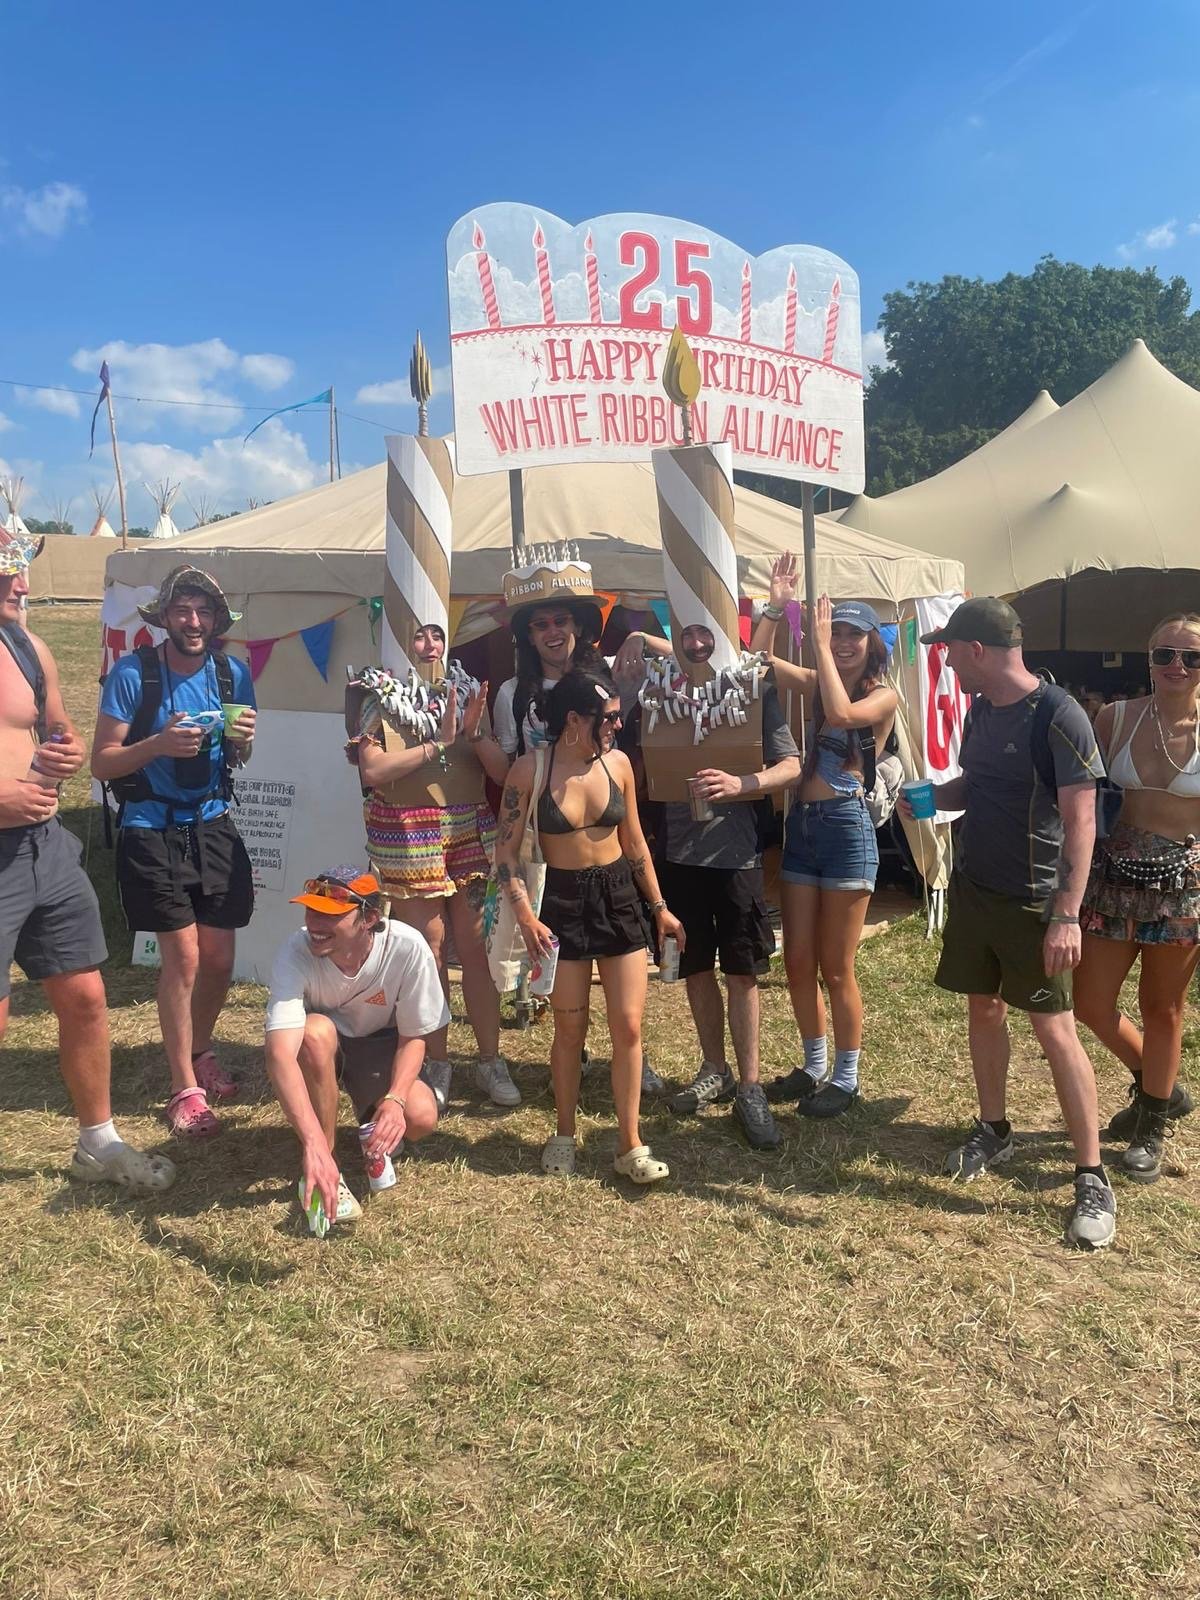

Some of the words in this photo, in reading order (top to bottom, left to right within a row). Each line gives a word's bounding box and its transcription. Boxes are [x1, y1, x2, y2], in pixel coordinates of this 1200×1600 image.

[618, 230, 714, 336] 25
[543, 338, 663, 383] HAPPY
[692, 348, 811, 406] RTHDAY
[479, 393, 592, 457] WHITE
[720, 404, 844, 473] ALLIANCE
[511, 581, 544, 597] RIBBON
